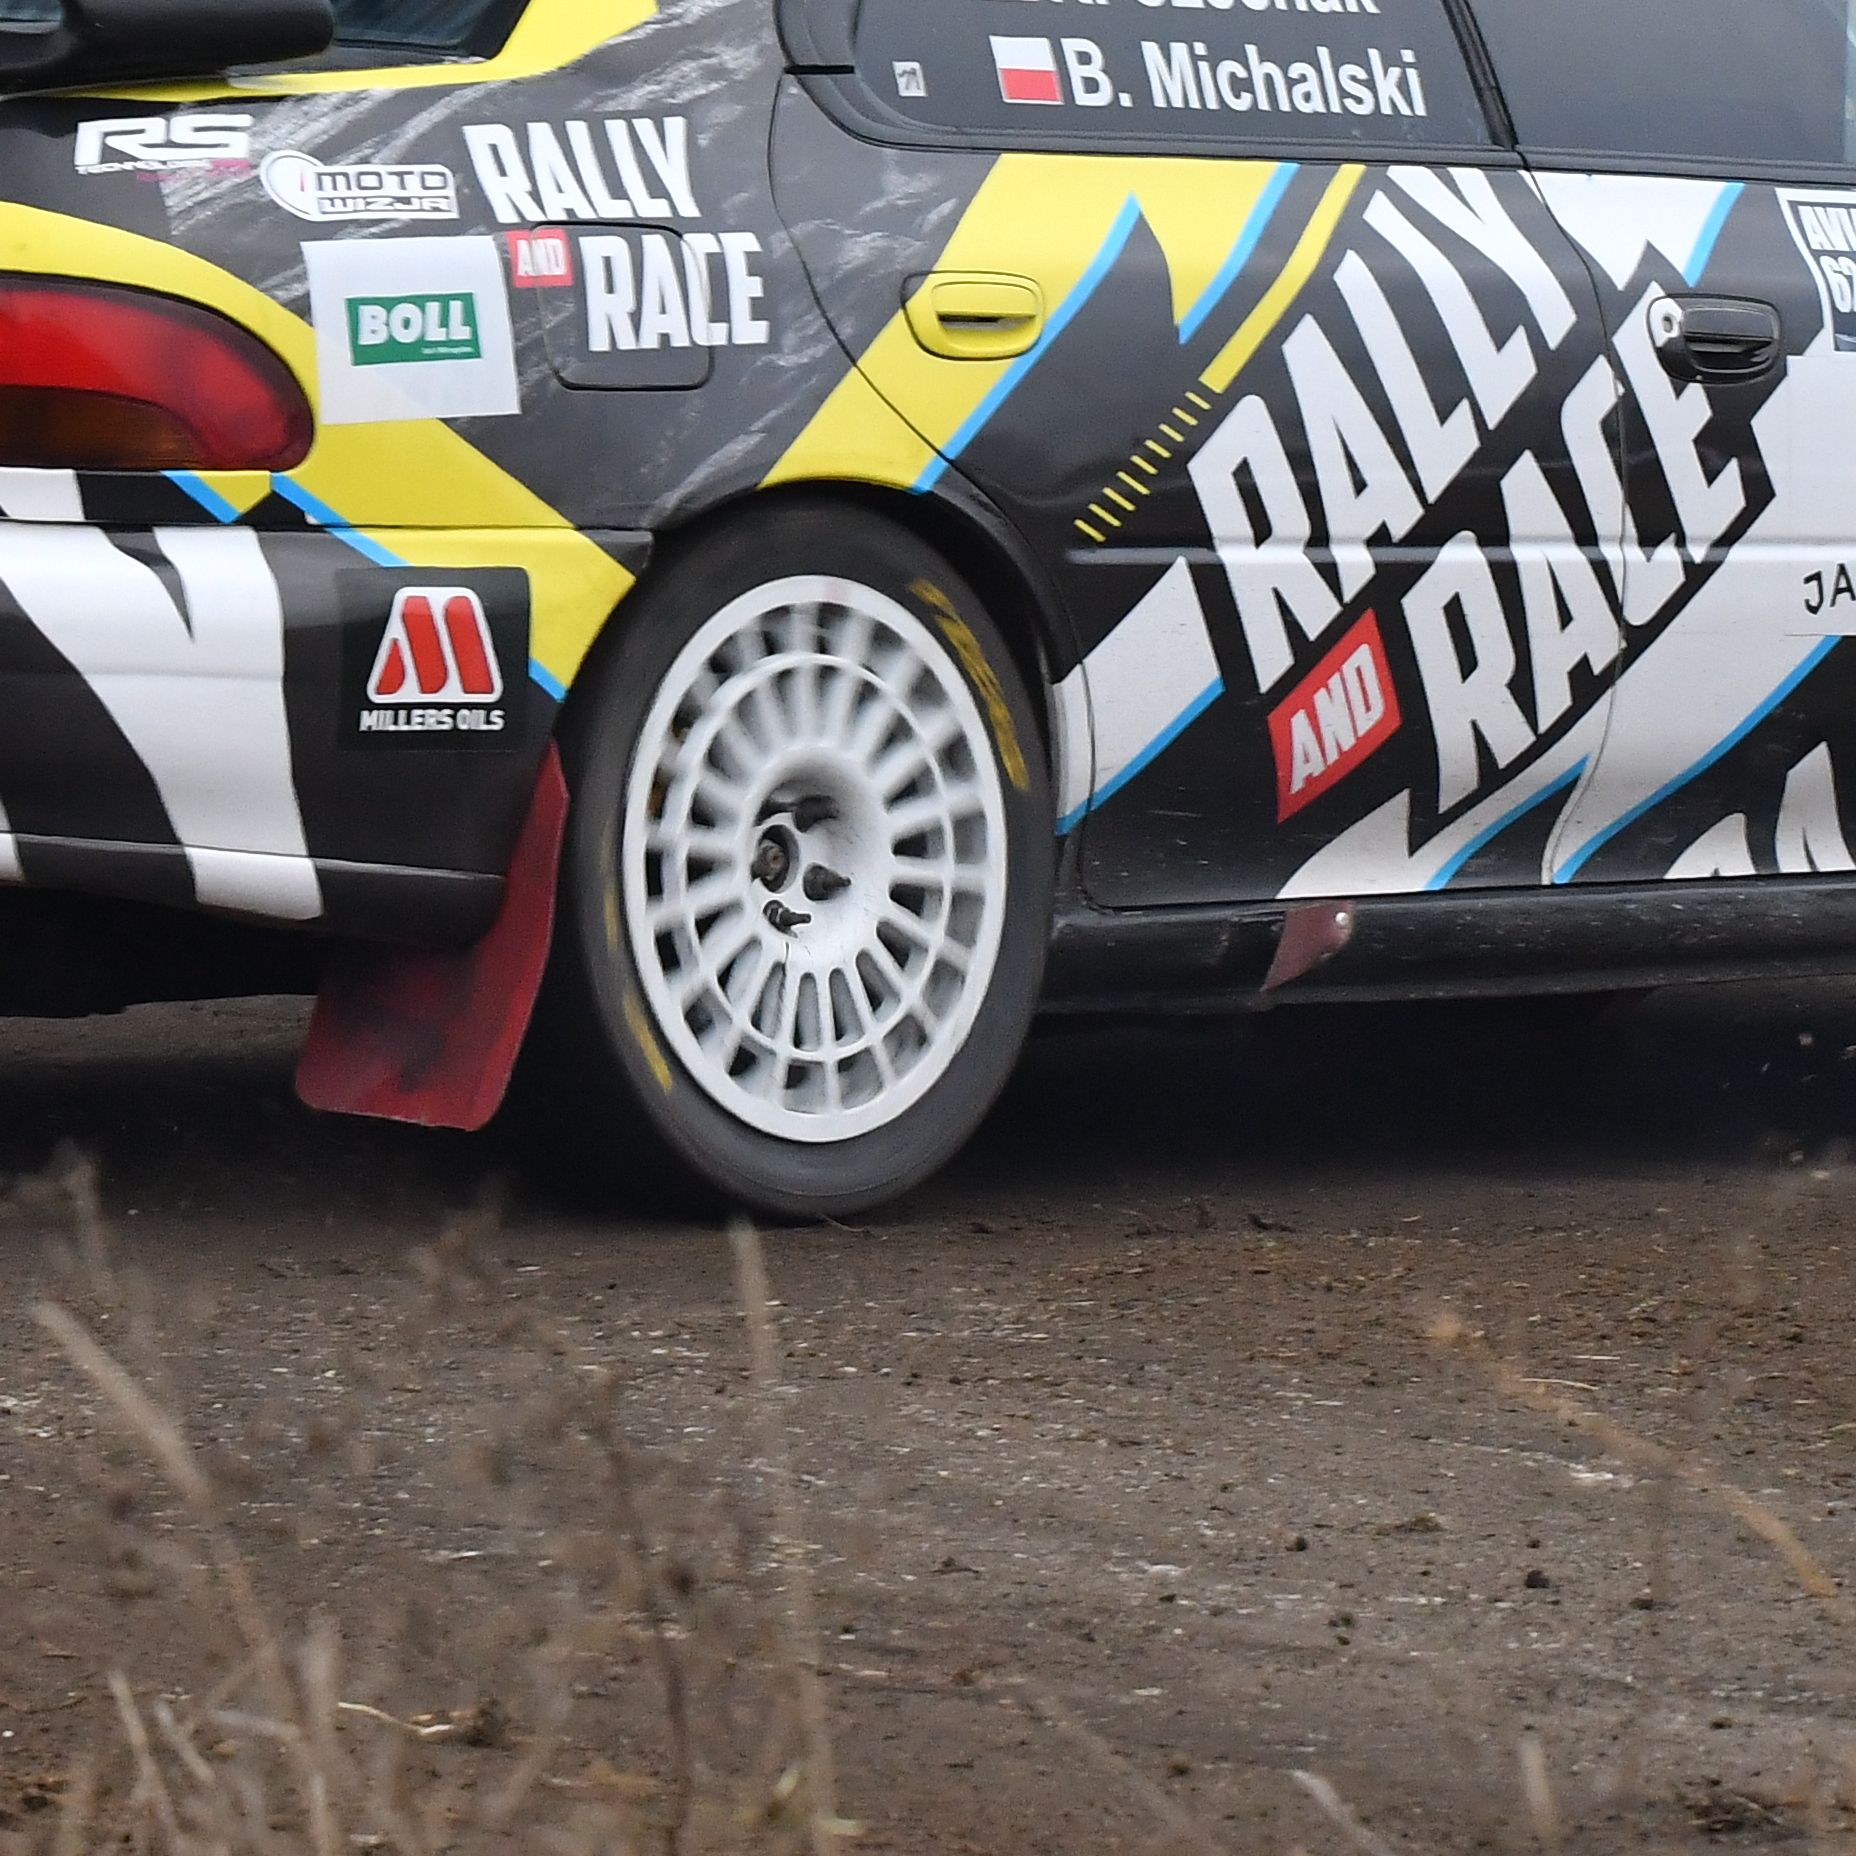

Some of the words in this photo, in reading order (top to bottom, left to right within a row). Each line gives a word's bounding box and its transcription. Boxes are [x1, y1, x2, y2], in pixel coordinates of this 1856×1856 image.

[1061, 37, 1133, 107] B.
[1142, 39, 1427, 117] Michalski
[74, 114, 254, 168] RS
[316, 170, 449, 192] MOTO
[462, 116, 702, 223] RALLY
[357, 301, 475, 346] BOLL
[578, 232, 771, 352] RACE
[1186, 162, 1578, 694] RALLY
[1401, 281, 1748, 815] RACE
[359, 708, 455, 732] MILLERS
[456, 708, 506, 732] OILS
[1288, 641, 1386, 796] AND
